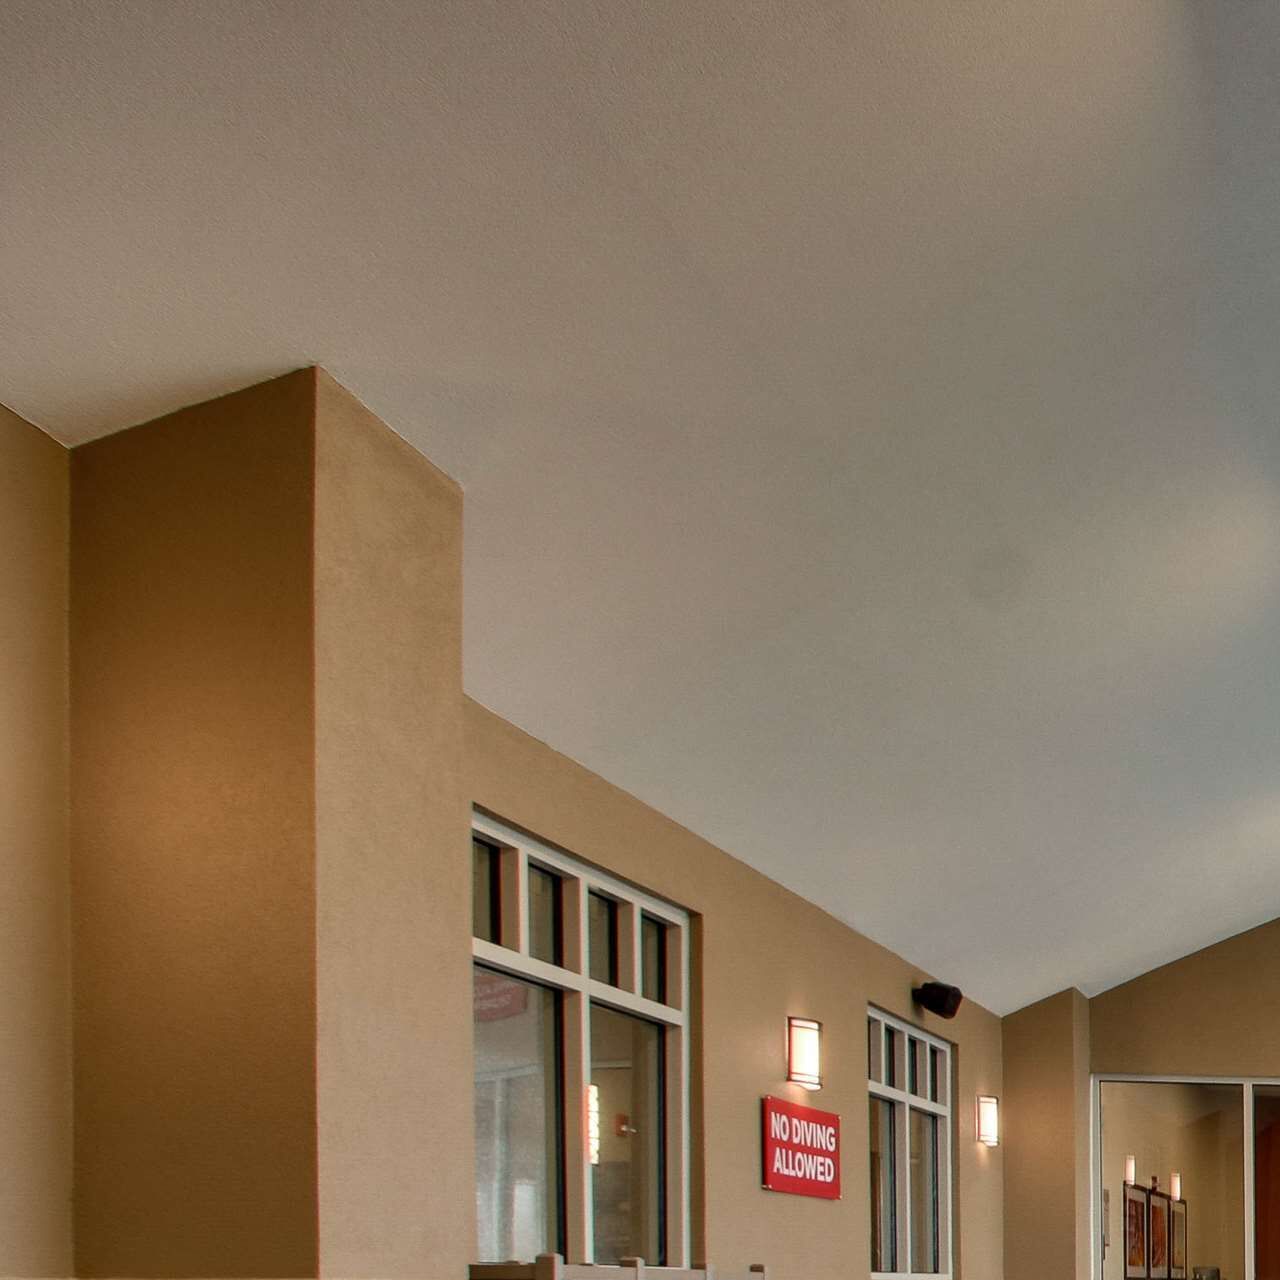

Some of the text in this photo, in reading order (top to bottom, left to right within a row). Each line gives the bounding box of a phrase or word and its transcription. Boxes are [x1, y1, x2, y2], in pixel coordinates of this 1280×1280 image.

[771, 1112, 836, 1152] NO DIVING
[773, 1147, 834, 1183] ALLOWED
